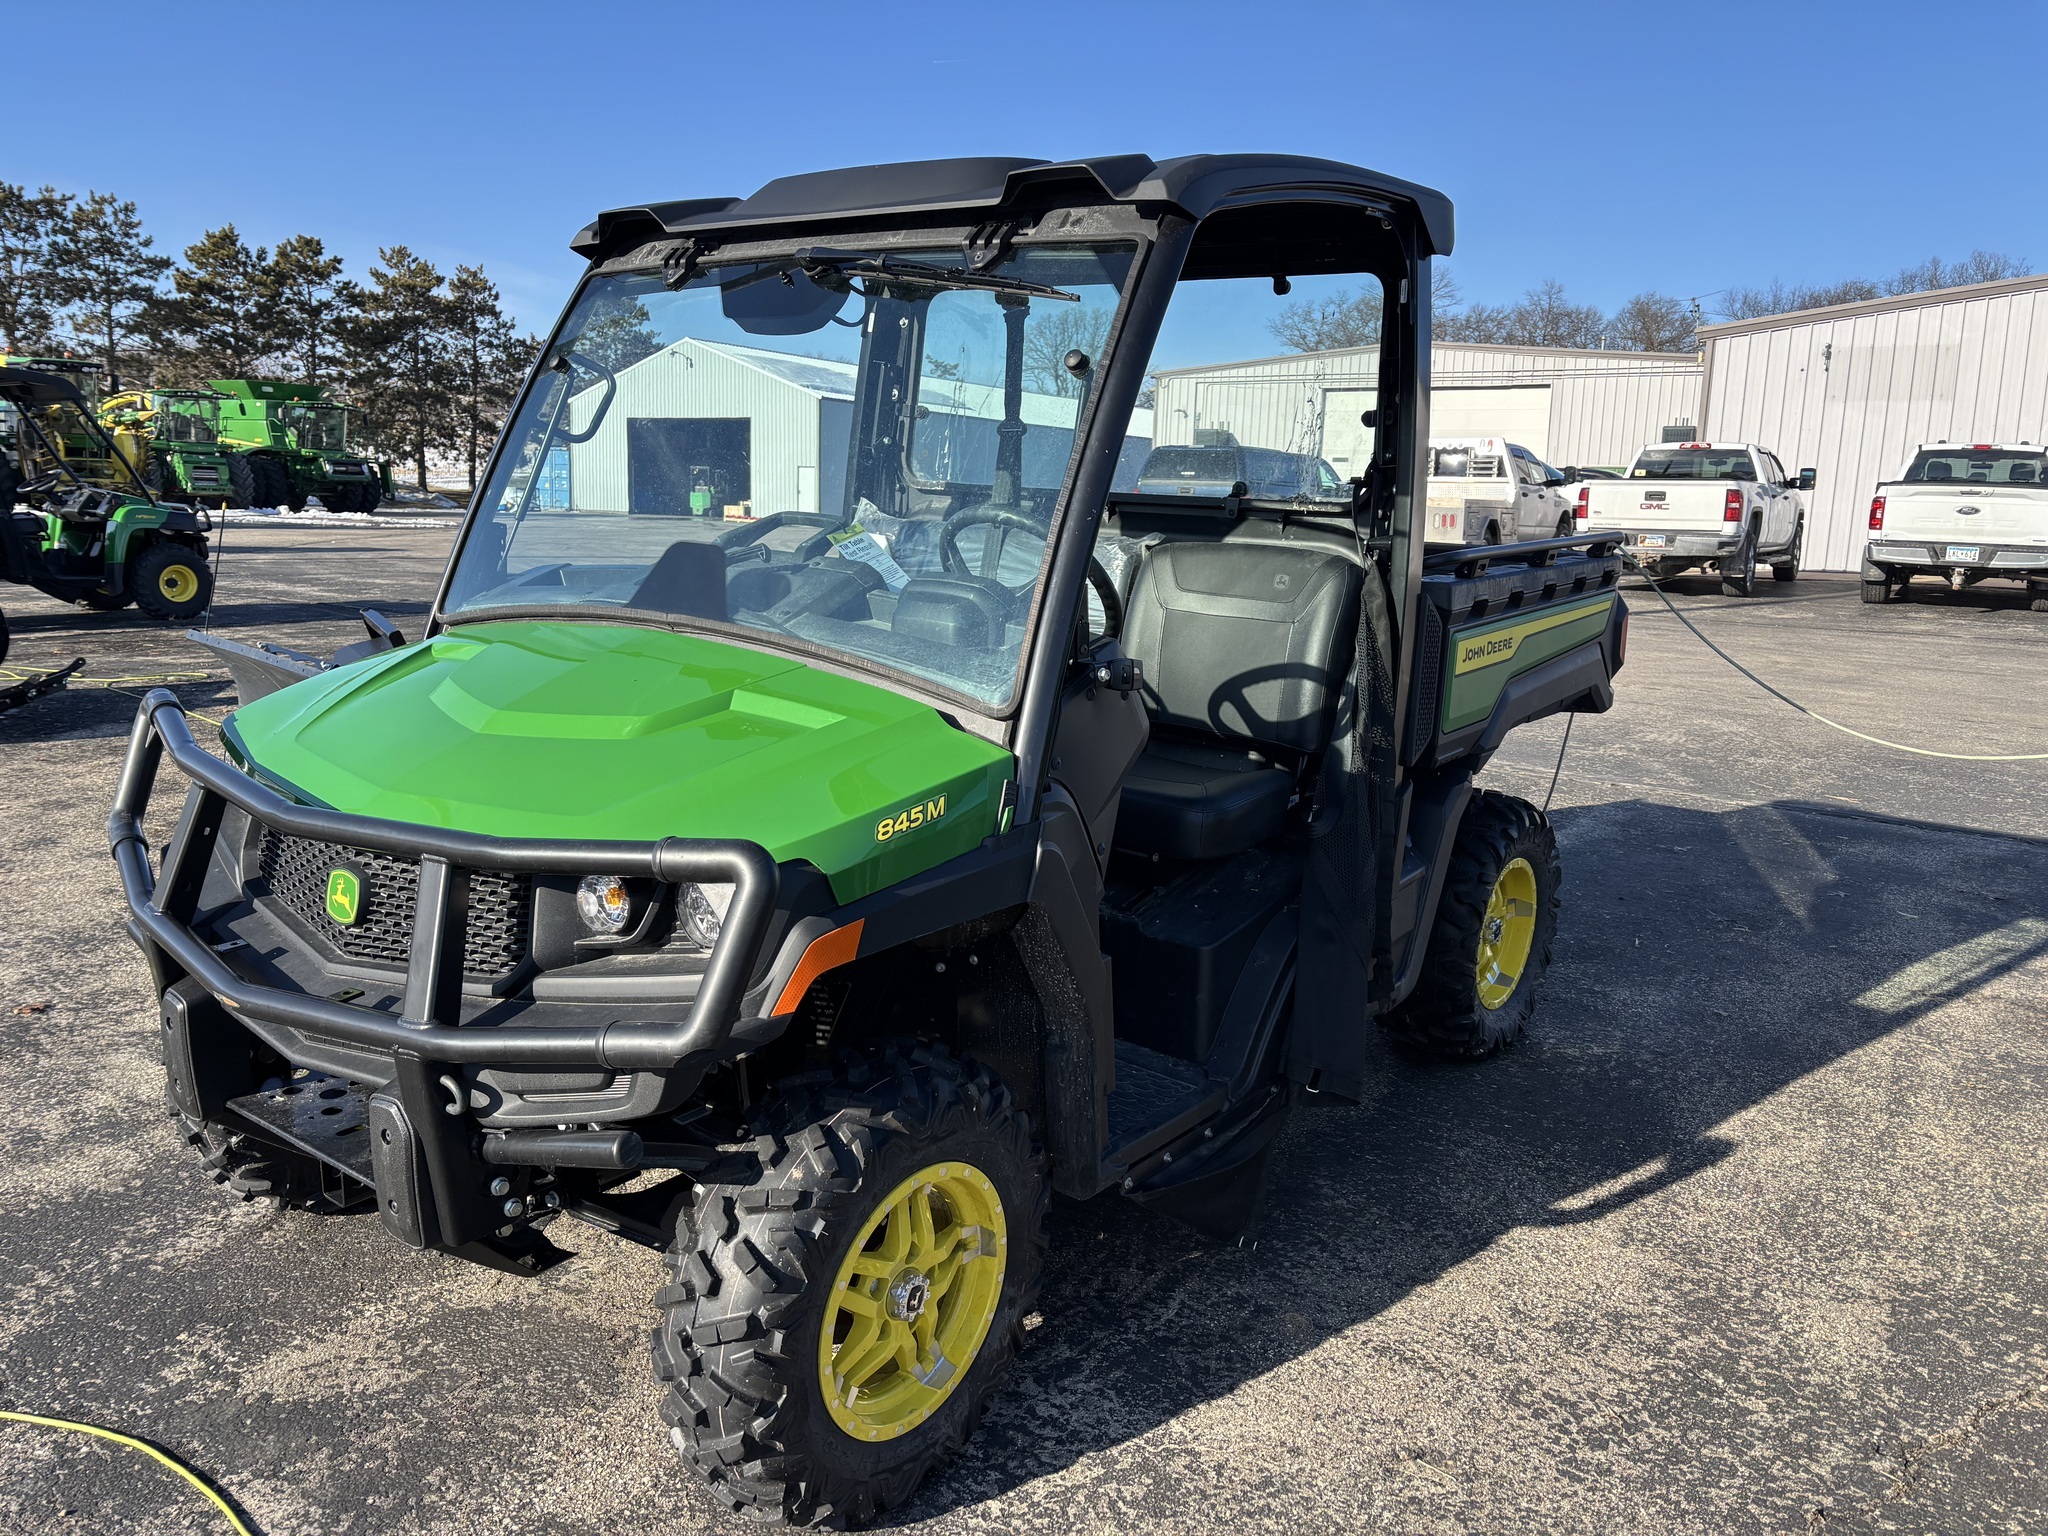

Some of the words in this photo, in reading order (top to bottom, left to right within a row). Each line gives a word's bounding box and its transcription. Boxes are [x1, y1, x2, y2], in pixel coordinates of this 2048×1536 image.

[839, 542, 850, 551] Tilt
[848, 537, 866, 549] Table
[845, 550, 859, 559] Test
[857, 542, 875, 555] Result
[1462, 645, 1485, 663] JOHN
[1486, 637, 1513, 655] DEERE
[877, 796, 945, 840] 845M
